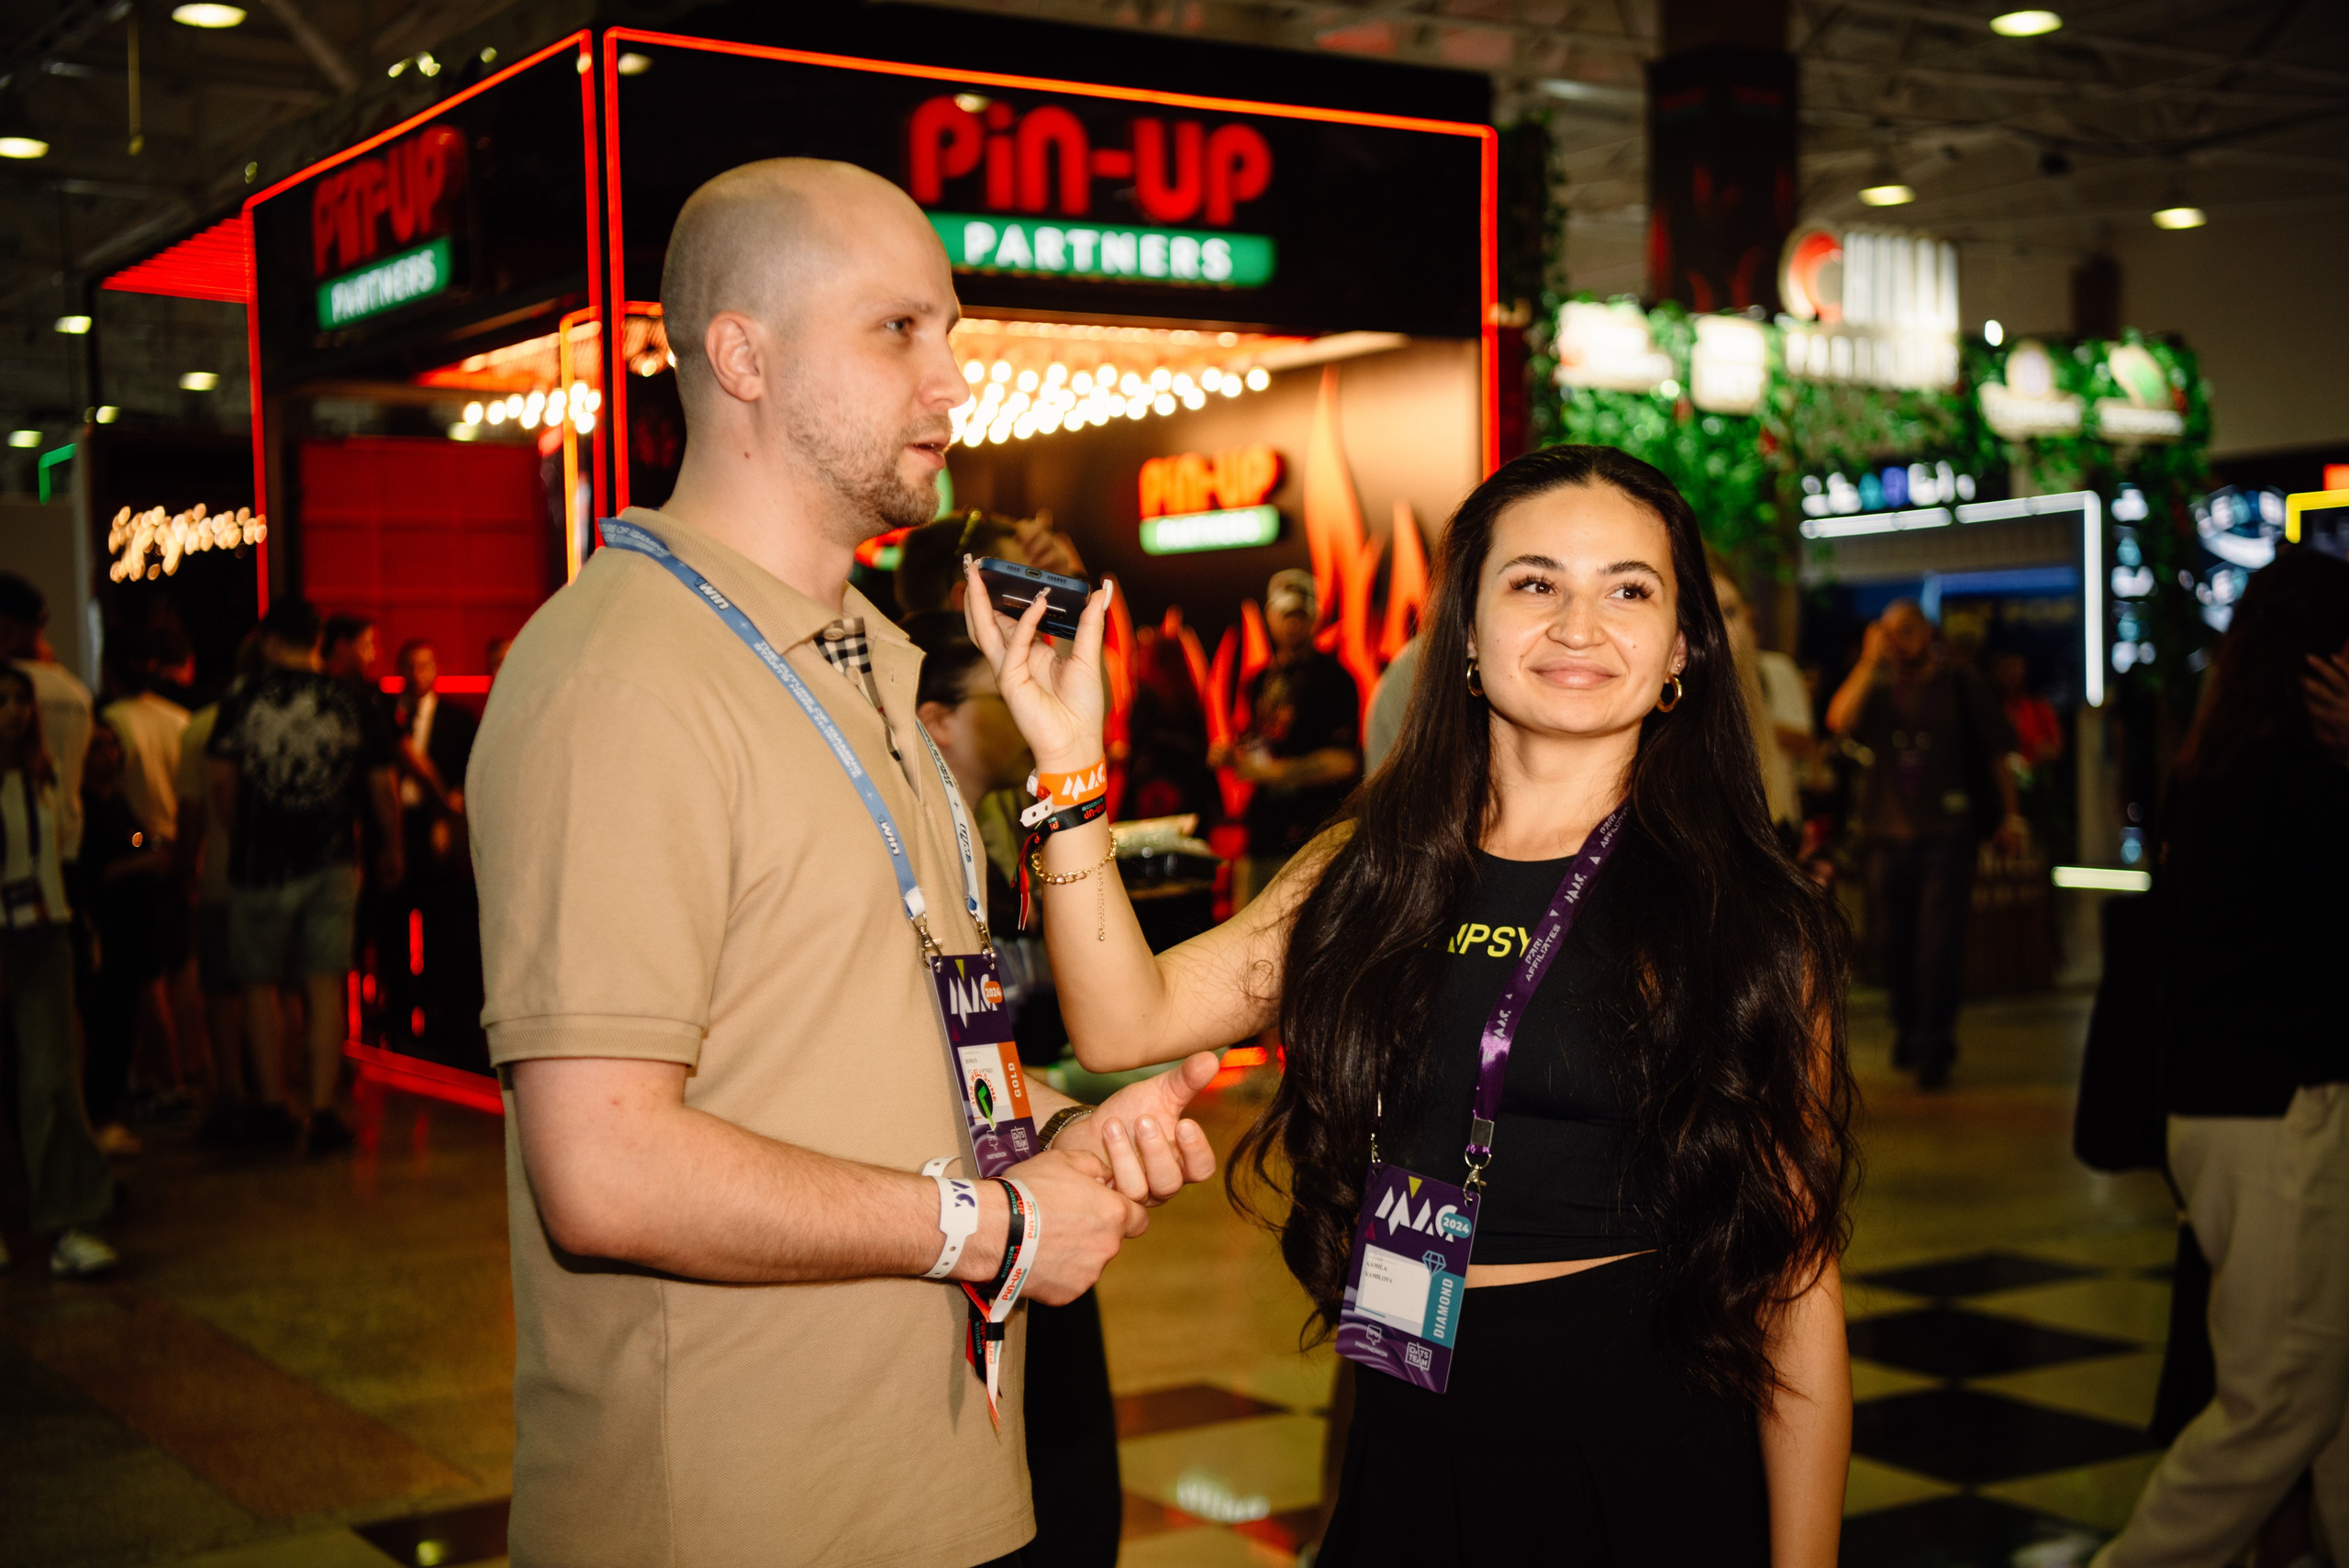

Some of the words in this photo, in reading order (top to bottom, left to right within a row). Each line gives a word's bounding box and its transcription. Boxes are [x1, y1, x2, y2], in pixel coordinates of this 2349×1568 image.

[964, 221, 1233, 282] PARTNERS
[331, 249, 437, 323] PARTNERS
[752, 643, 789, 683] STARTS
[788, 684, 816, 714] HERE
[761, 640, 779, 665] THE
[779, 663, 816, 706] FUTURE
[814, 707, 829, 724] OF
[1525, 938, 1543, 964] PARI
[1526, 924, 1561, 982] AFFILIATES
[985, 987, 1002, 998] 2024
[1008, 1062, 1021, 1098] GOLD
[1442, 1217, 1470, 1235] 2024
[1433, 1278, 1453, 1340] DIAMOND
[1354, 1340, 1388, 1358] PARTNERKIN
